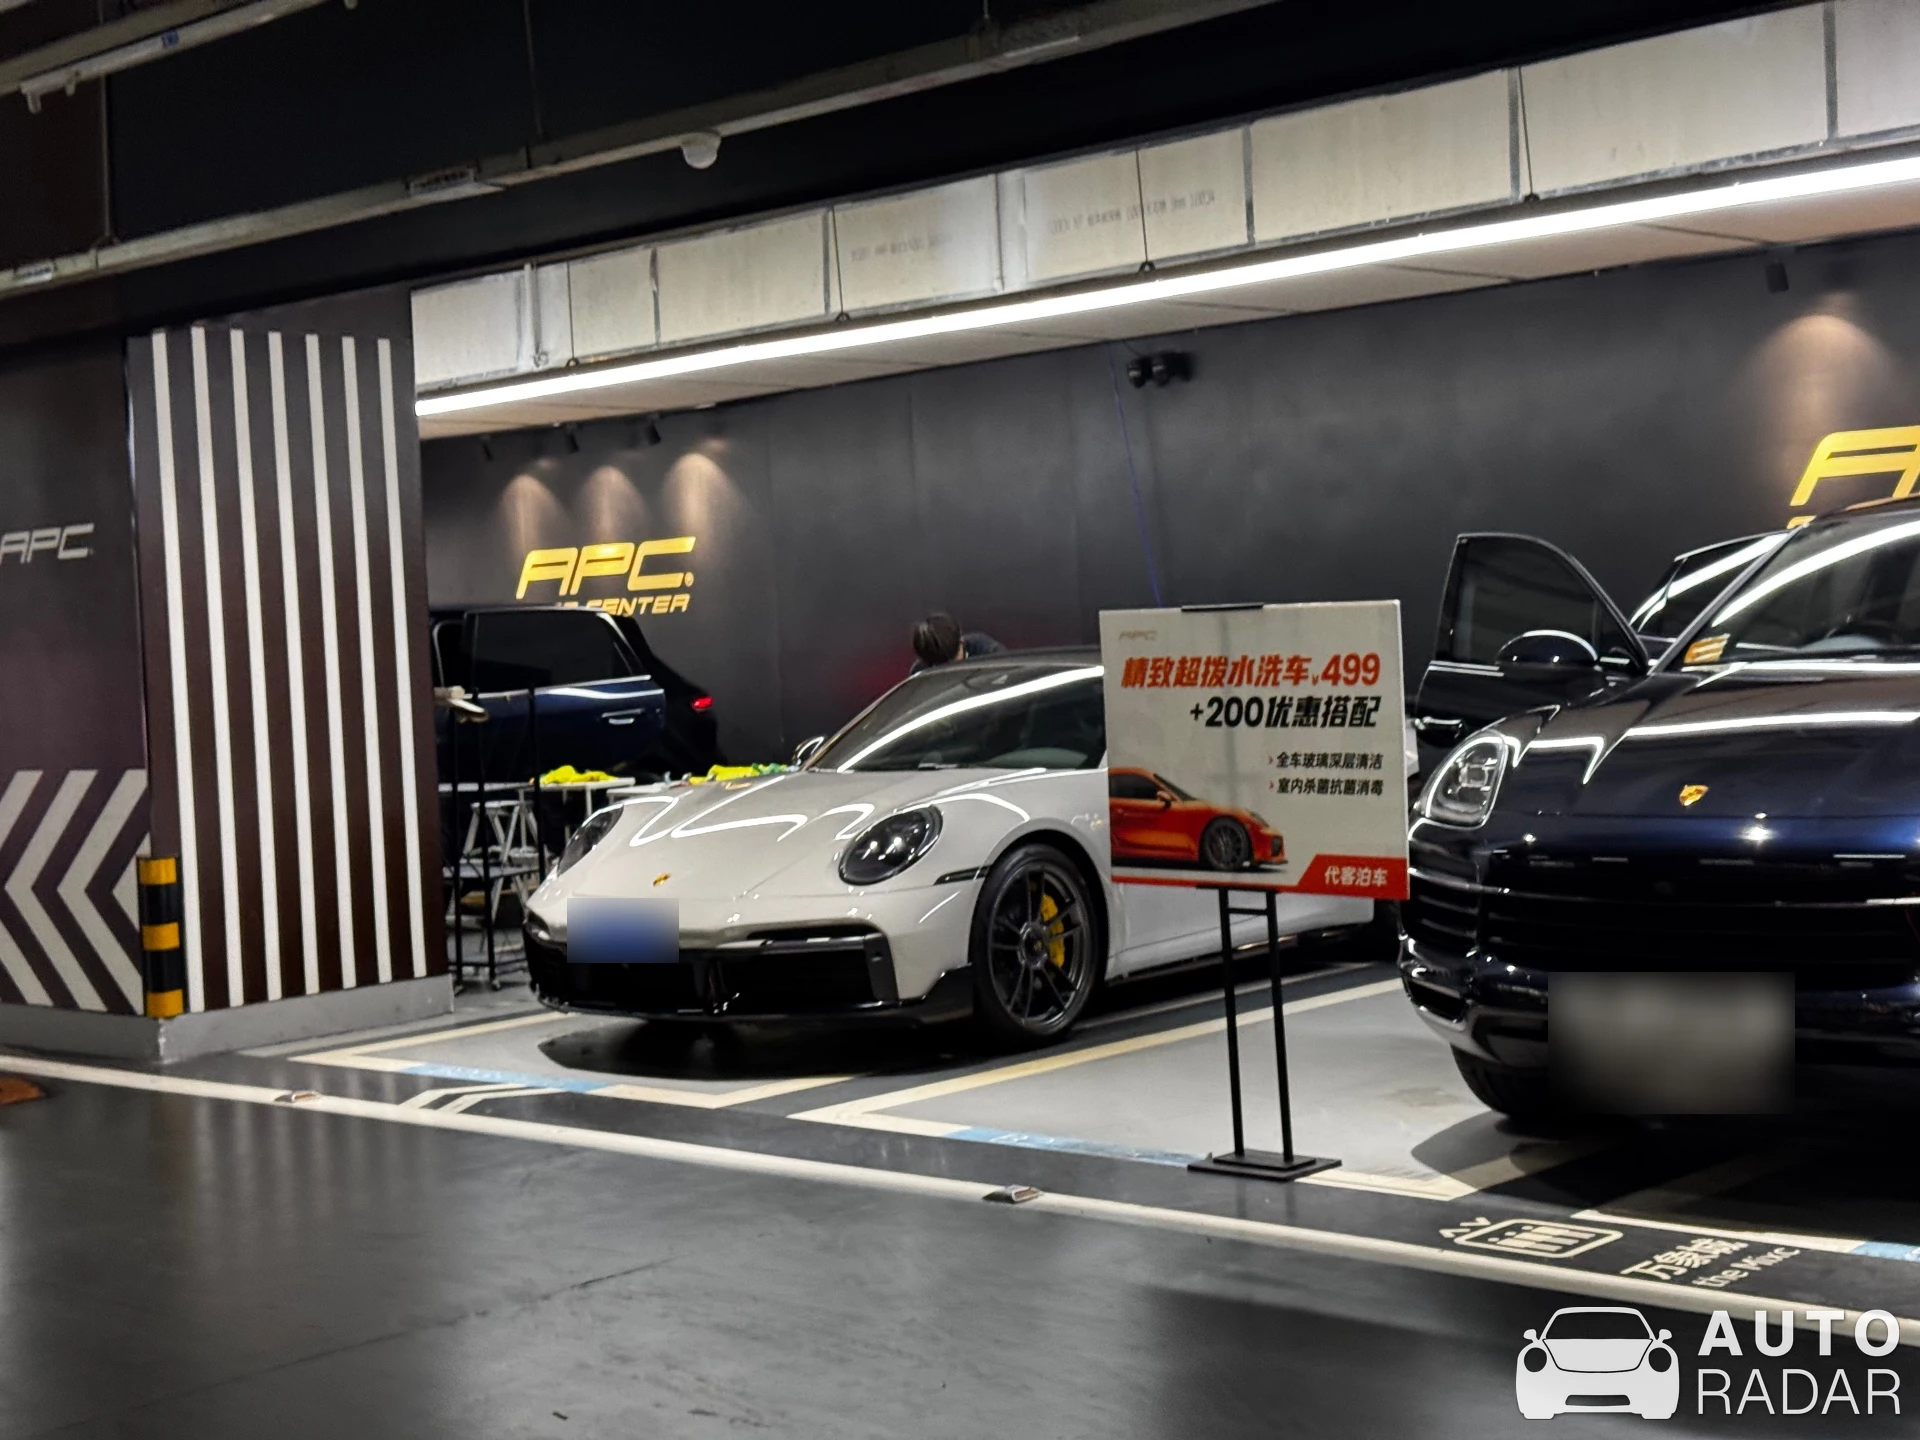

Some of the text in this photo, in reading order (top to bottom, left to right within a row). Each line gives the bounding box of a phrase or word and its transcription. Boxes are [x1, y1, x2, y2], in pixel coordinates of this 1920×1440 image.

[1789, 425, 1920, 507] A
[1324, 865, 1388, 887] 代客泊车
